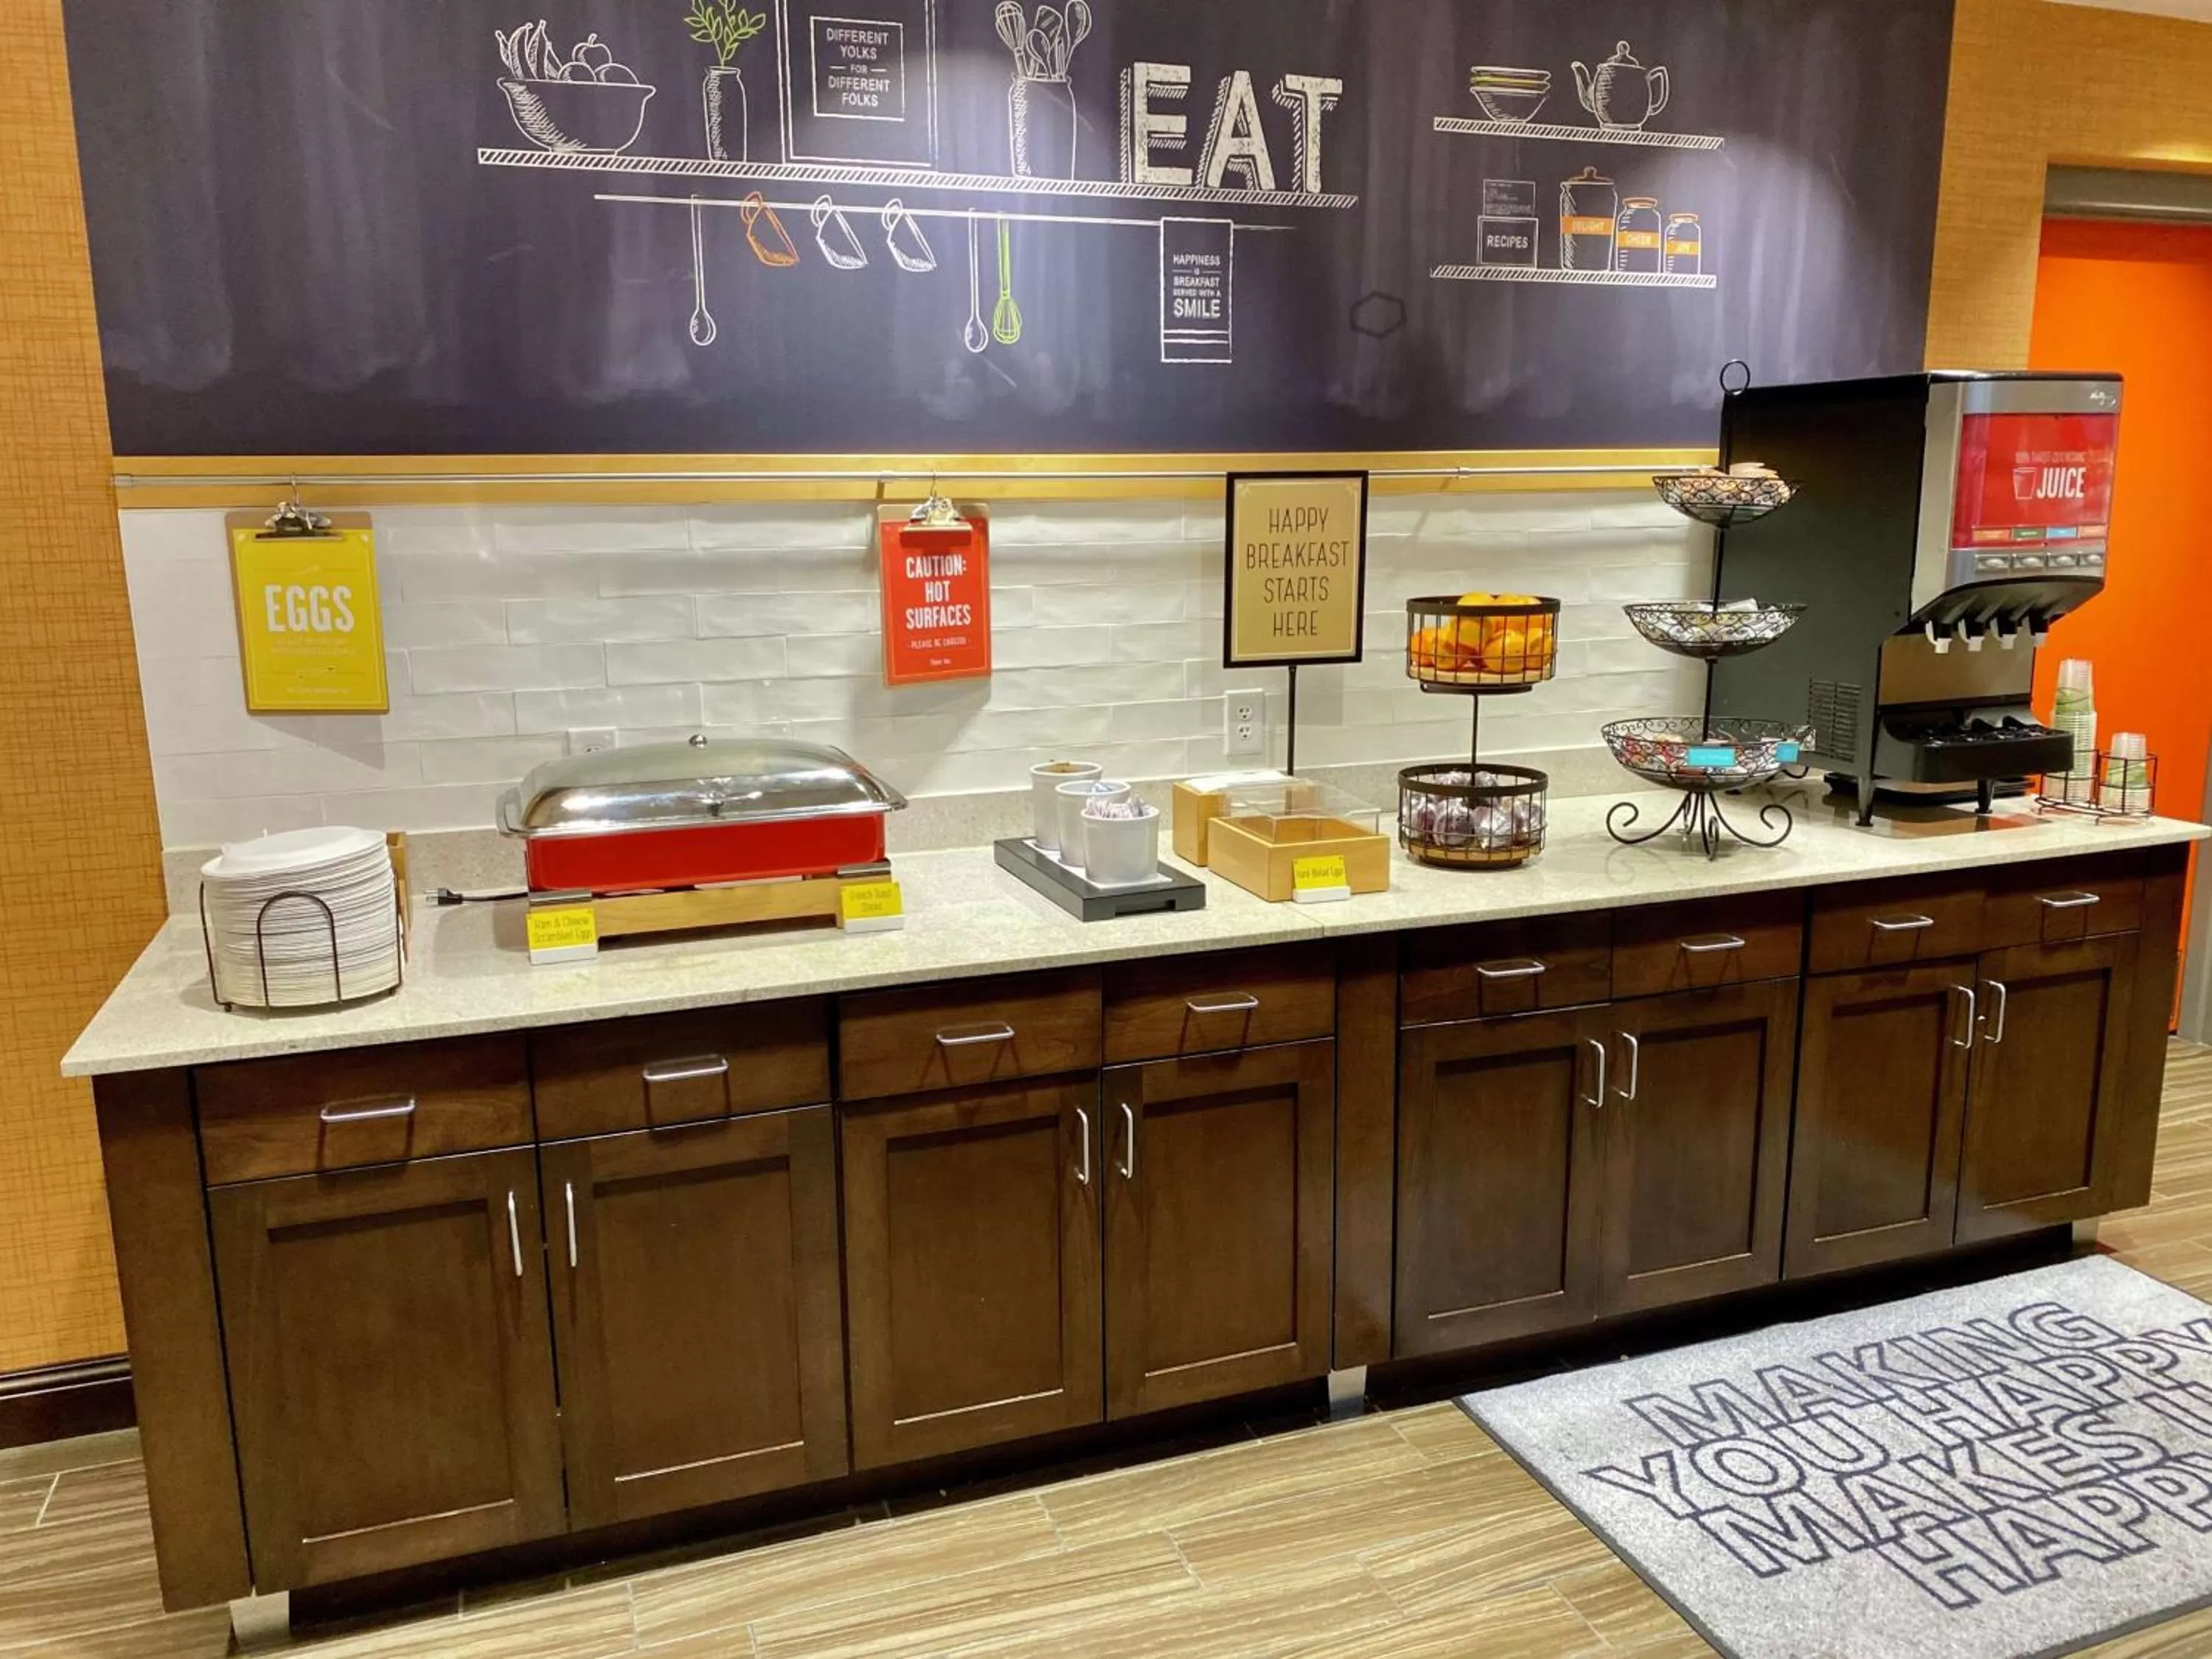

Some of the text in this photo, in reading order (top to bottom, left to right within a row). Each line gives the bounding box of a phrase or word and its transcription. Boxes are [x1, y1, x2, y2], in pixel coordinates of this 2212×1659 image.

[826, 28, 889, 45] DIFFERENT
[840, 46, 877, 60] YOLKS
[850, 64, 868, 73] FOR
[828, 76, 891, 92] DIFFERENT
[841, 93, 879, 107] FOLKS
[1121, 62, 1343, 193] EAT
[1486, 234, 1529, 248] RECIPES
[1173, 253, 1221, 266] HAPPINESS
[1173, 276, 1220, 288] BREAKFAST
[1216, 289, 1222, 298] A
[1173, 298, 1221, 319] SMILE
[2036, 467, 2087, 499] JUICE
[1268, 507, 1329, 534] HAPPY
[905, 554, 967, 579] CAUTION:
[1246, 540, 1351, 569] BREAKFAST
[925, 580, 950, 602] HOT
[1263, 576, 1330, 604] STARTS
[264, 584, 355, 633] EGGS
[905, 604, 972, 630] SURFACES
[1273, 611, 1319, 636] HERE
[1624, 1301, 2128, 1450] MAKING
[1578, 1410, 1891, 1520] YOU
[1694, 1405, 2171, 1578] MAKES
[1872, 1451, 2212, 1610] HAPP
